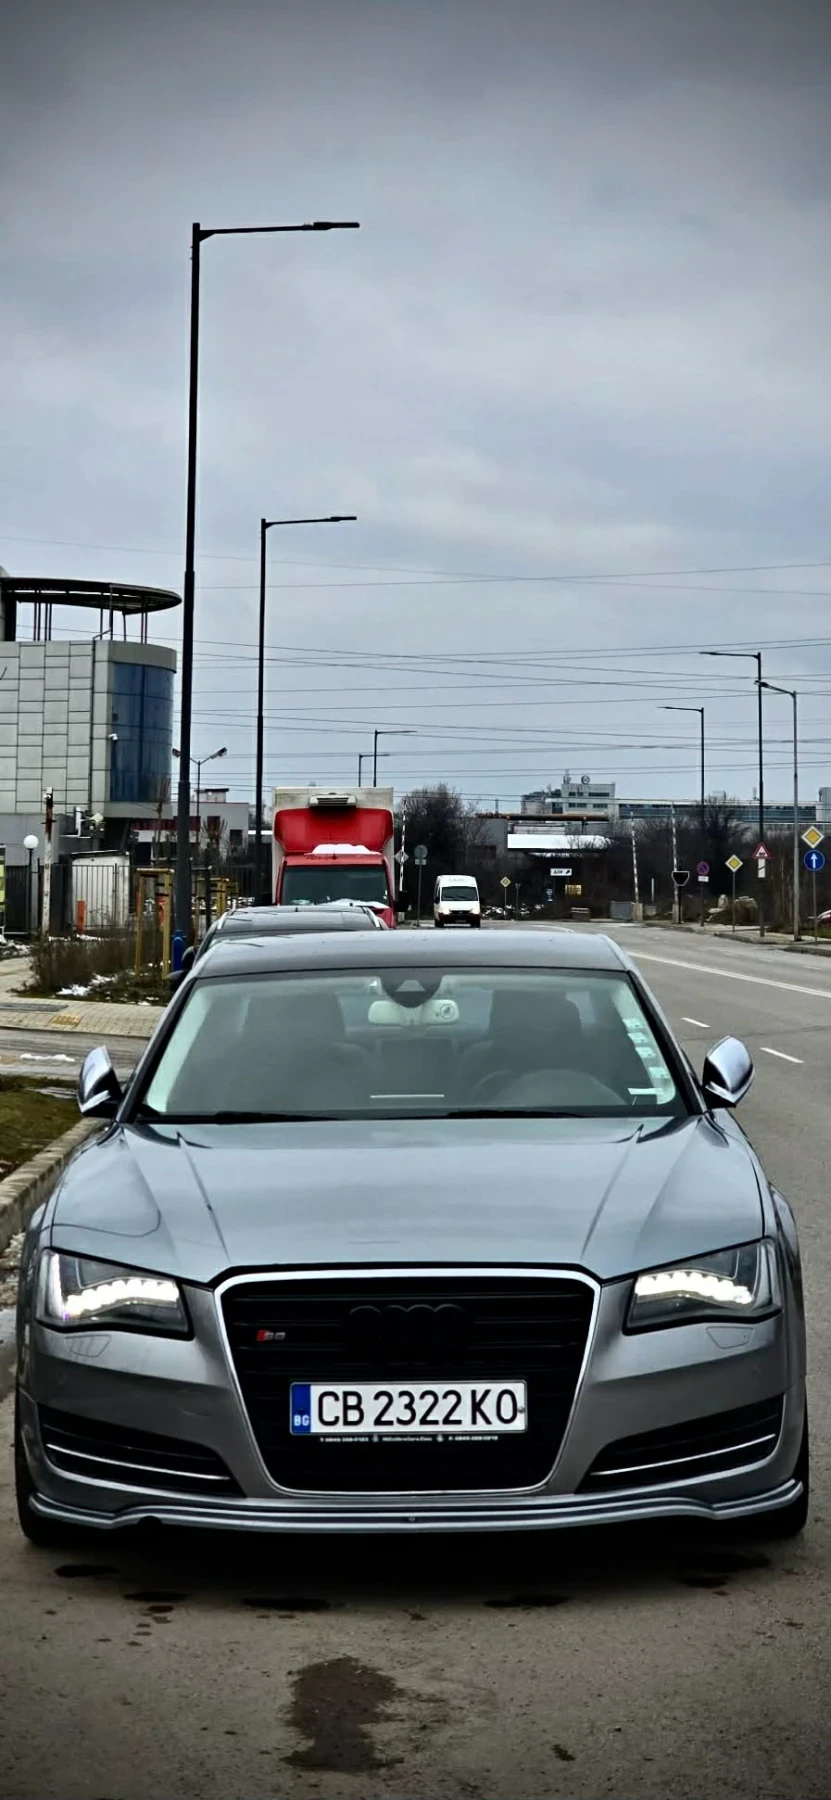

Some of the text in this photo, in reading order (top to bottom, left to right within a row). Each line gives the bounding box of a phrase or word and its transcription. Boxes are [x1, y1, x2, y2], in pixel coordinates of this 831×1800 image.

[318, 1388, 518, 1426] CB 2322 KO
[293, 1414, 310, 1426] BG
